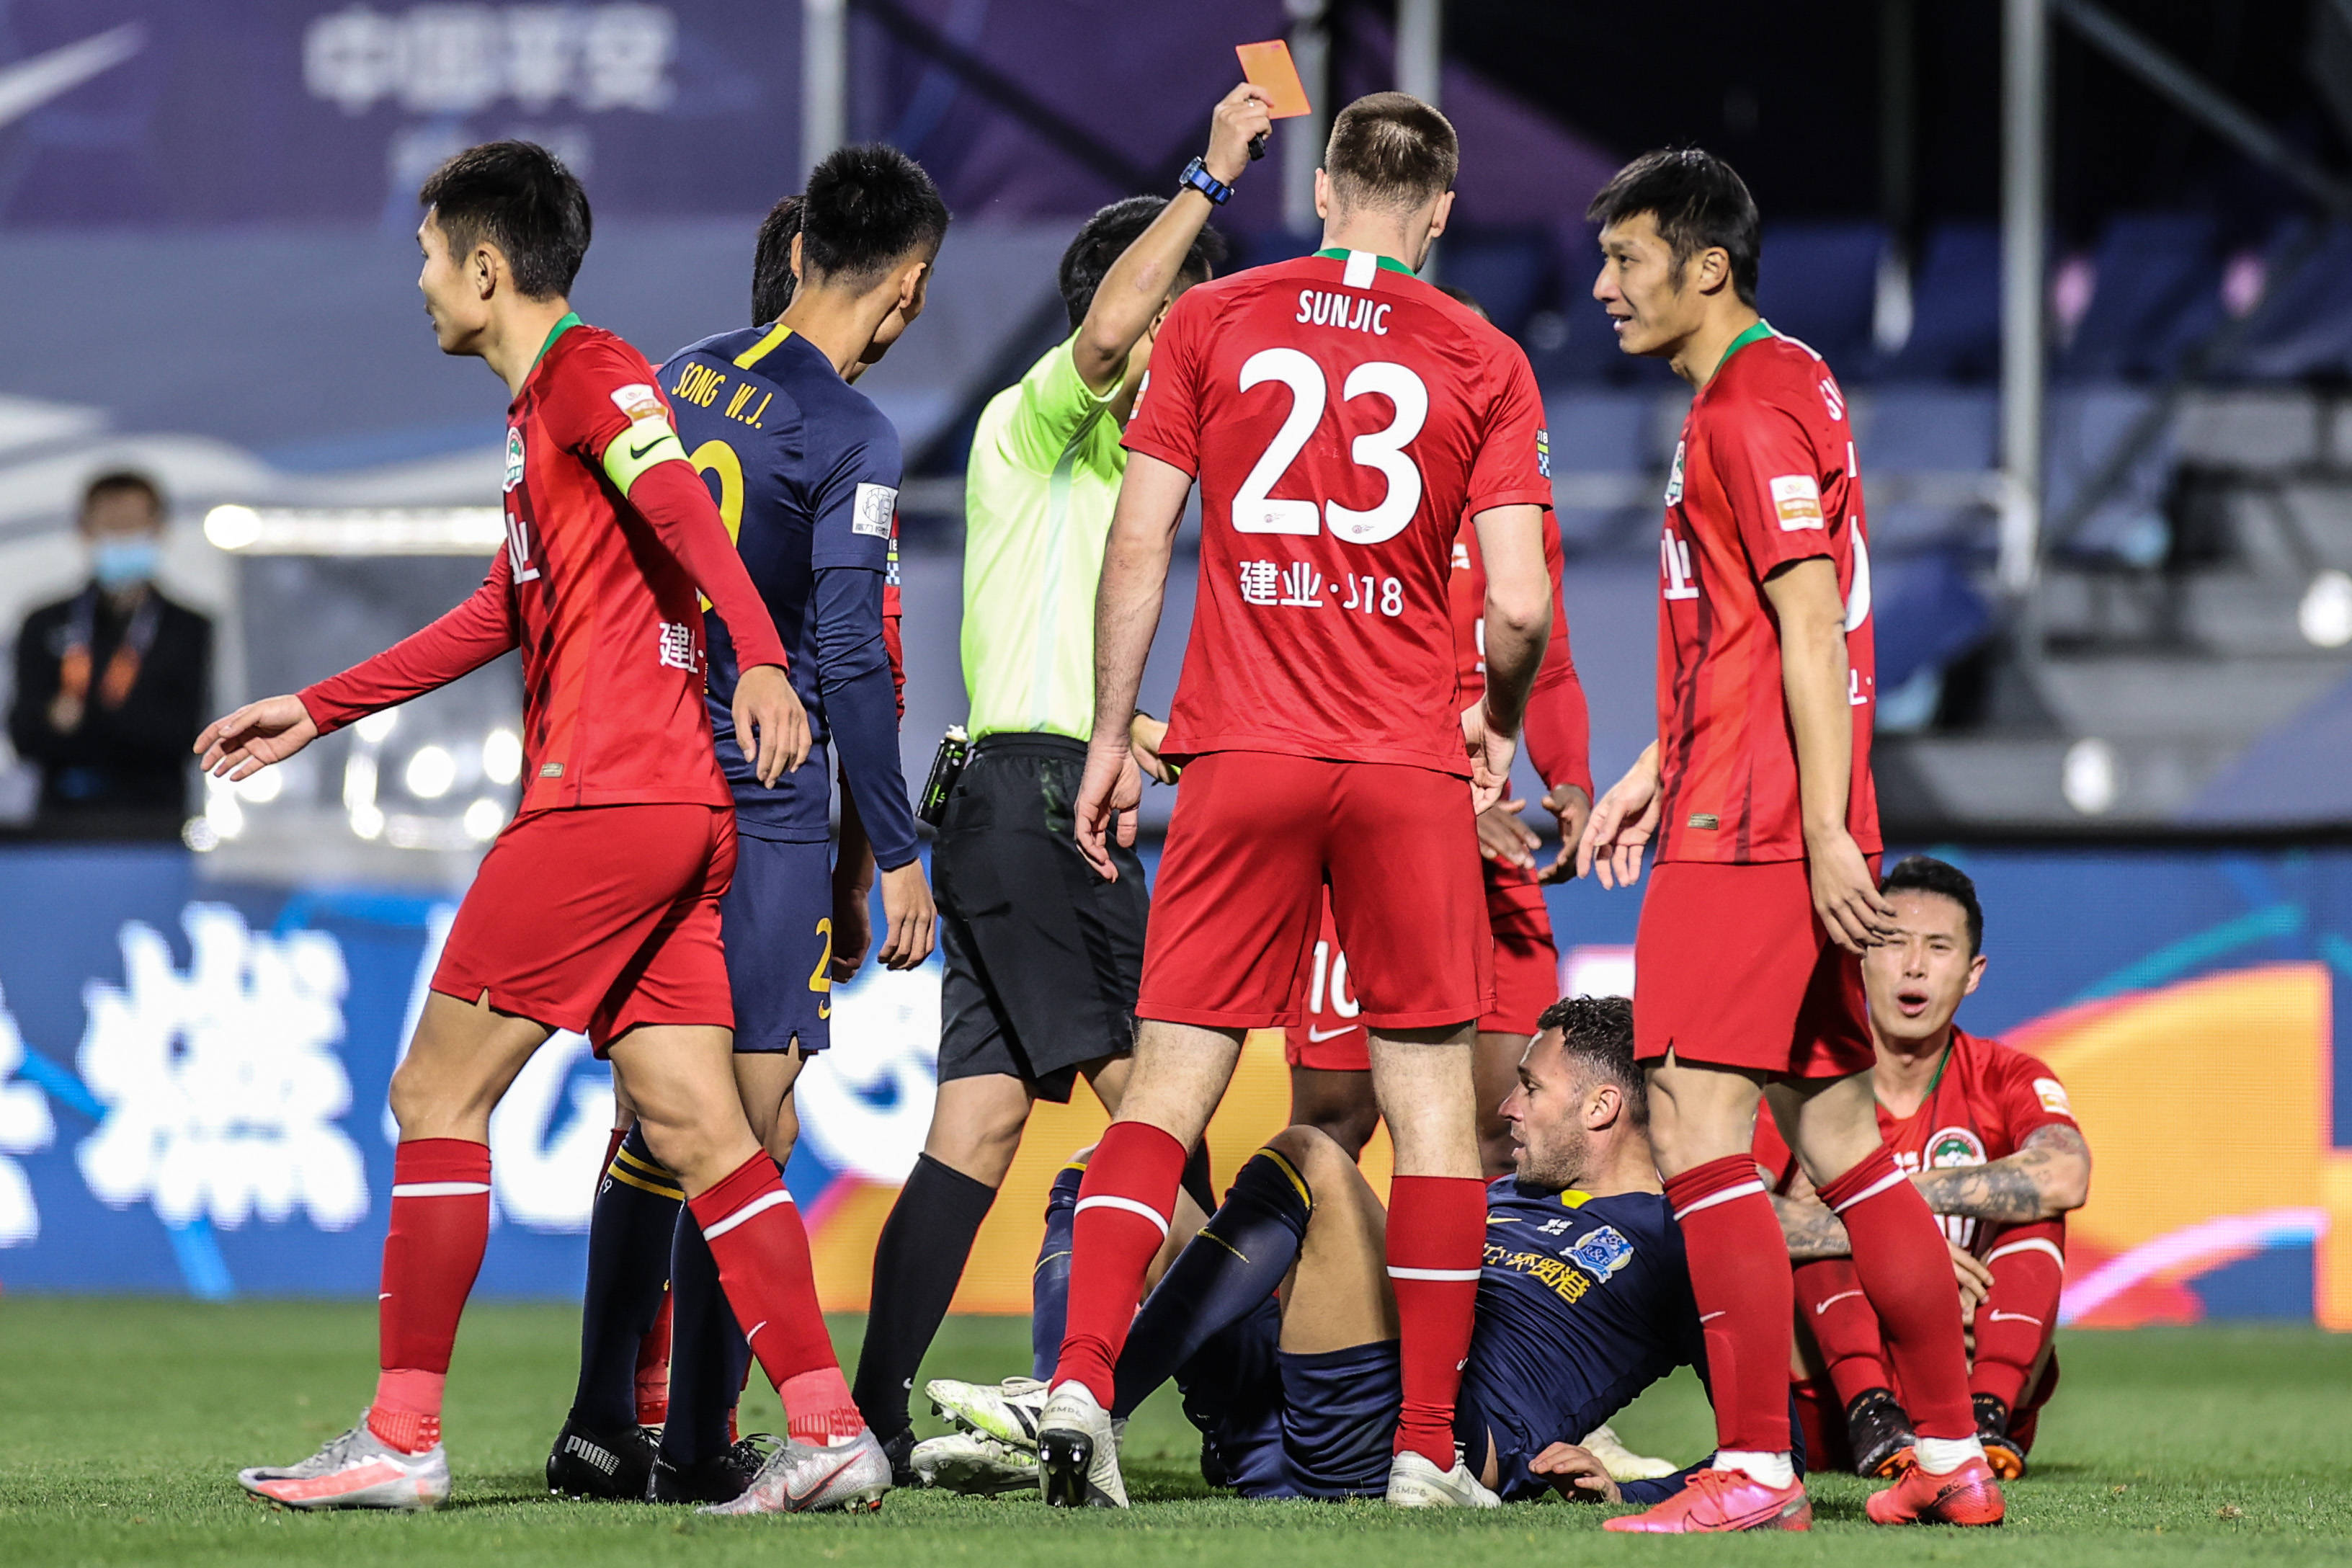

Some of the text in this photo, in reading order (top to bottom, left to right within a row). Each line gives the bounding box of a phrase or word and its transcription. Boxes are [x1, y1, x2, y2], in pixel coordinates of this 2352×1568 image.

[1296, 289, 1391, 336] SUNJIC
[671, 362, 772, 429] SONG W.J.
[1231, 347, 1430, 545] 23
[564, 1435, 620, 1476] PUMA
